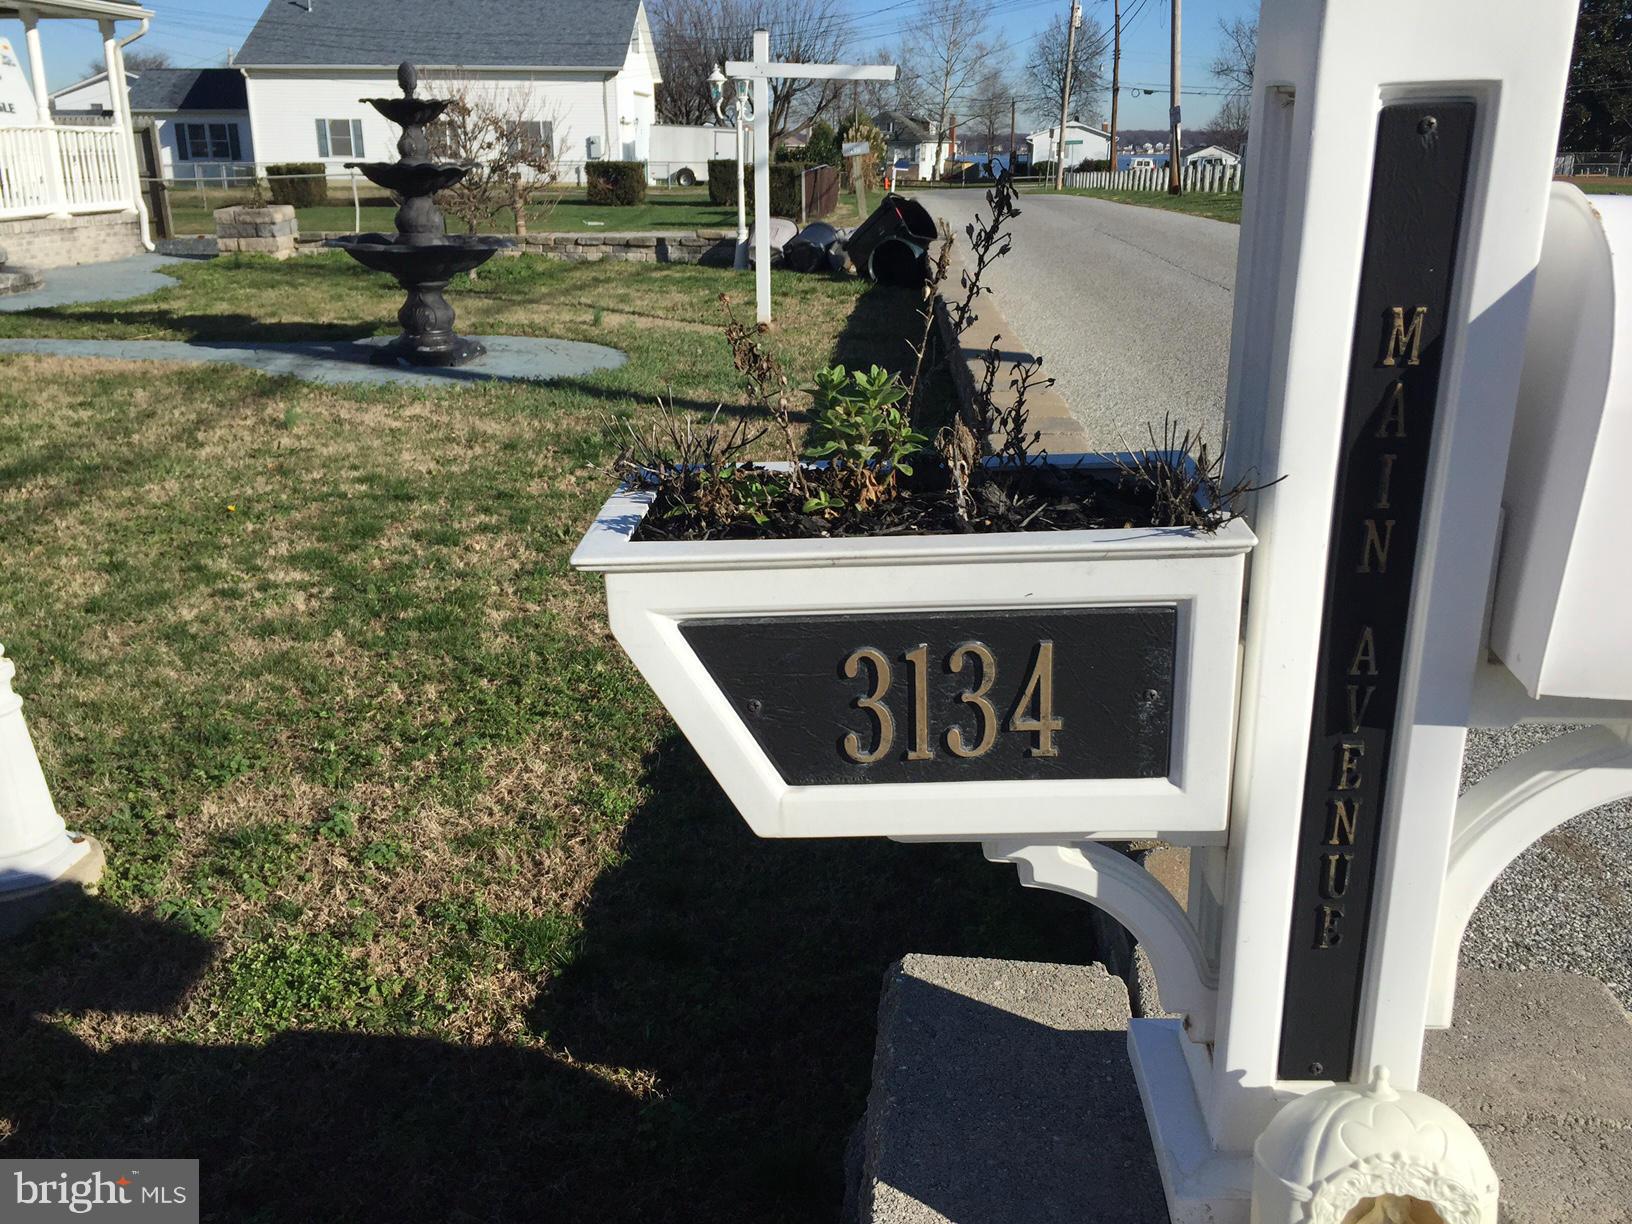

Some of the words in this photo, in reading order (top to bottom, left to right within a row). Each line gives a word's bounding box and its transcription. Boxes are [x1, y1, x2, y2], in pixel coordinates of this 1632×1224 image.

[1356, 306, 1427, 574] MAIN
[843, 639, 1064, 763] 3134
[1312, 626, 1379, 949] AVENUE
